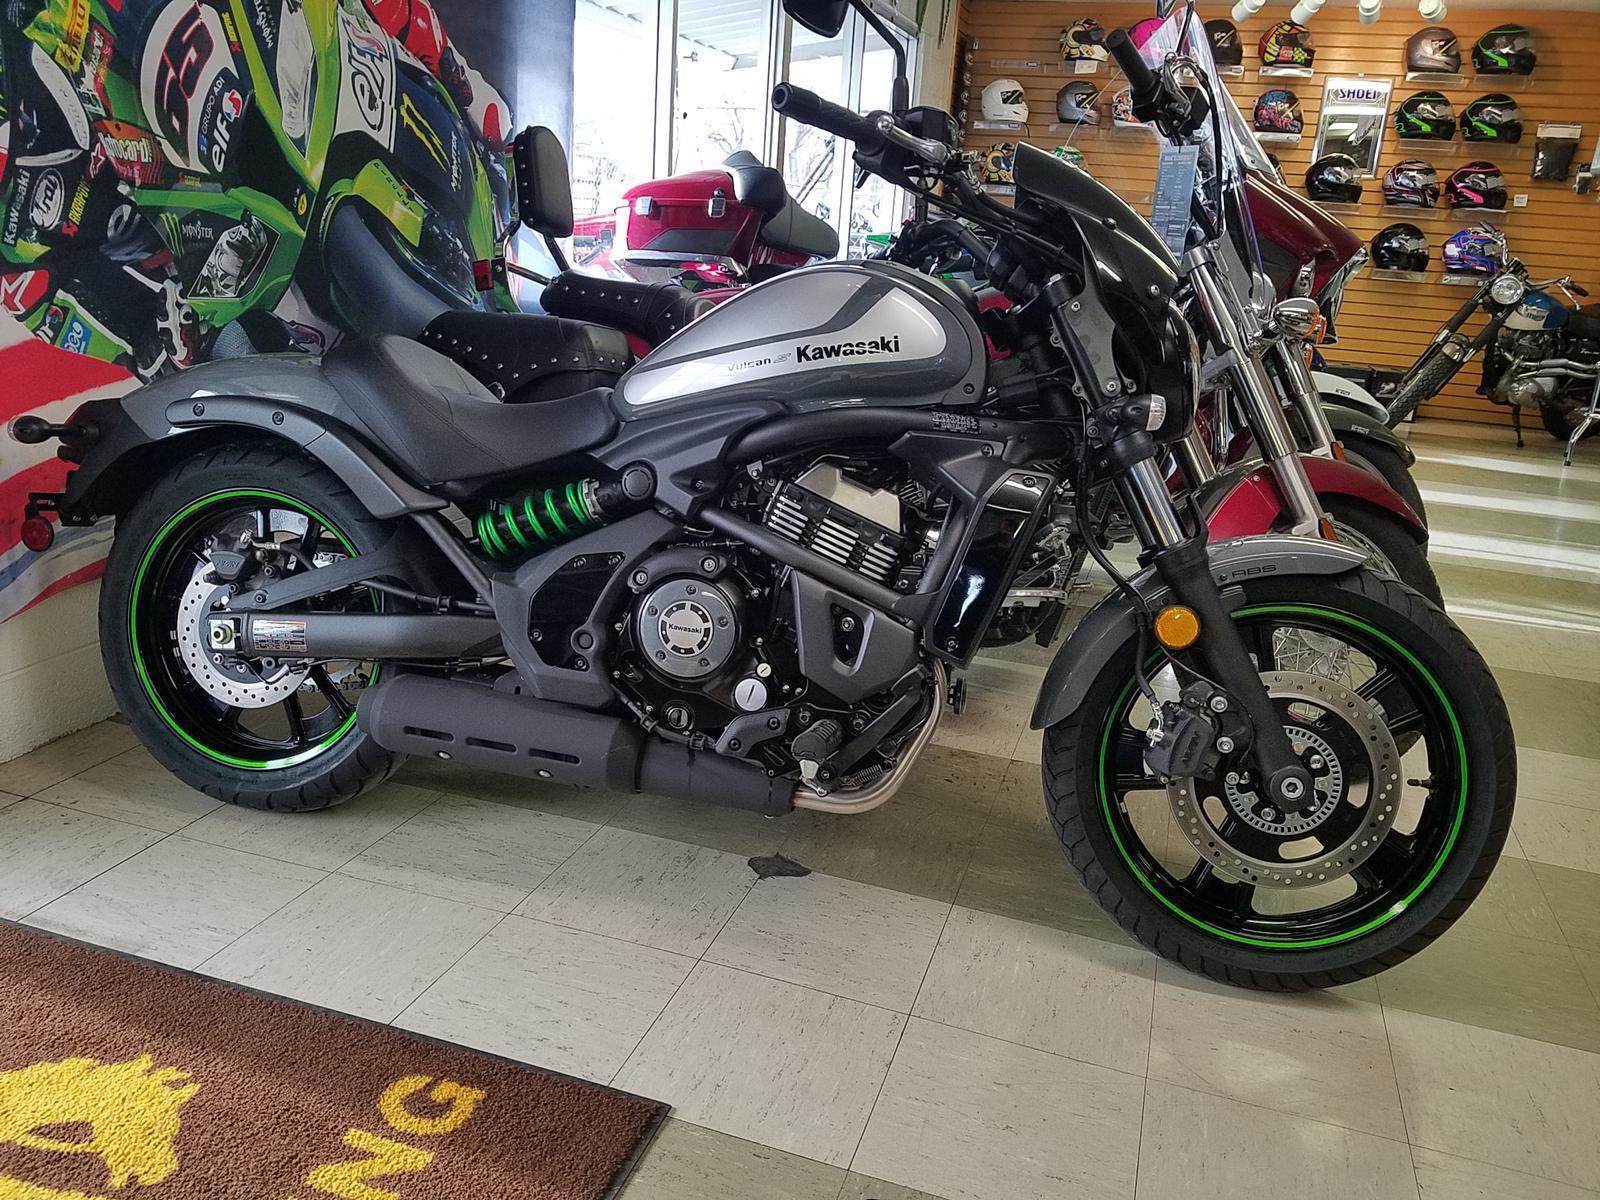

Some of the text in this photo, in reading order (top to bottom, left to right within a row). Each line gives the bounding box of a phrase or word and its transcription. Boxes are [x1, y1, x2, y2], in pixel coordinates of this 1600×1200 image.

[202, 95, 216, 134] GRUPO
[213, 76, 225, 96] ADI
[1339, 88, 1377, 99] SHOEI
[212, 112, 230, 173] elf
[4, 168, 30, 245] Kawasaki
[728, 358, 771, 372] Vulcan
[796, 336, 900, 363] Kawasaki
[1231, 564, 1278, 578] ABS
[668, 623, 702, 635] Kawasaki
